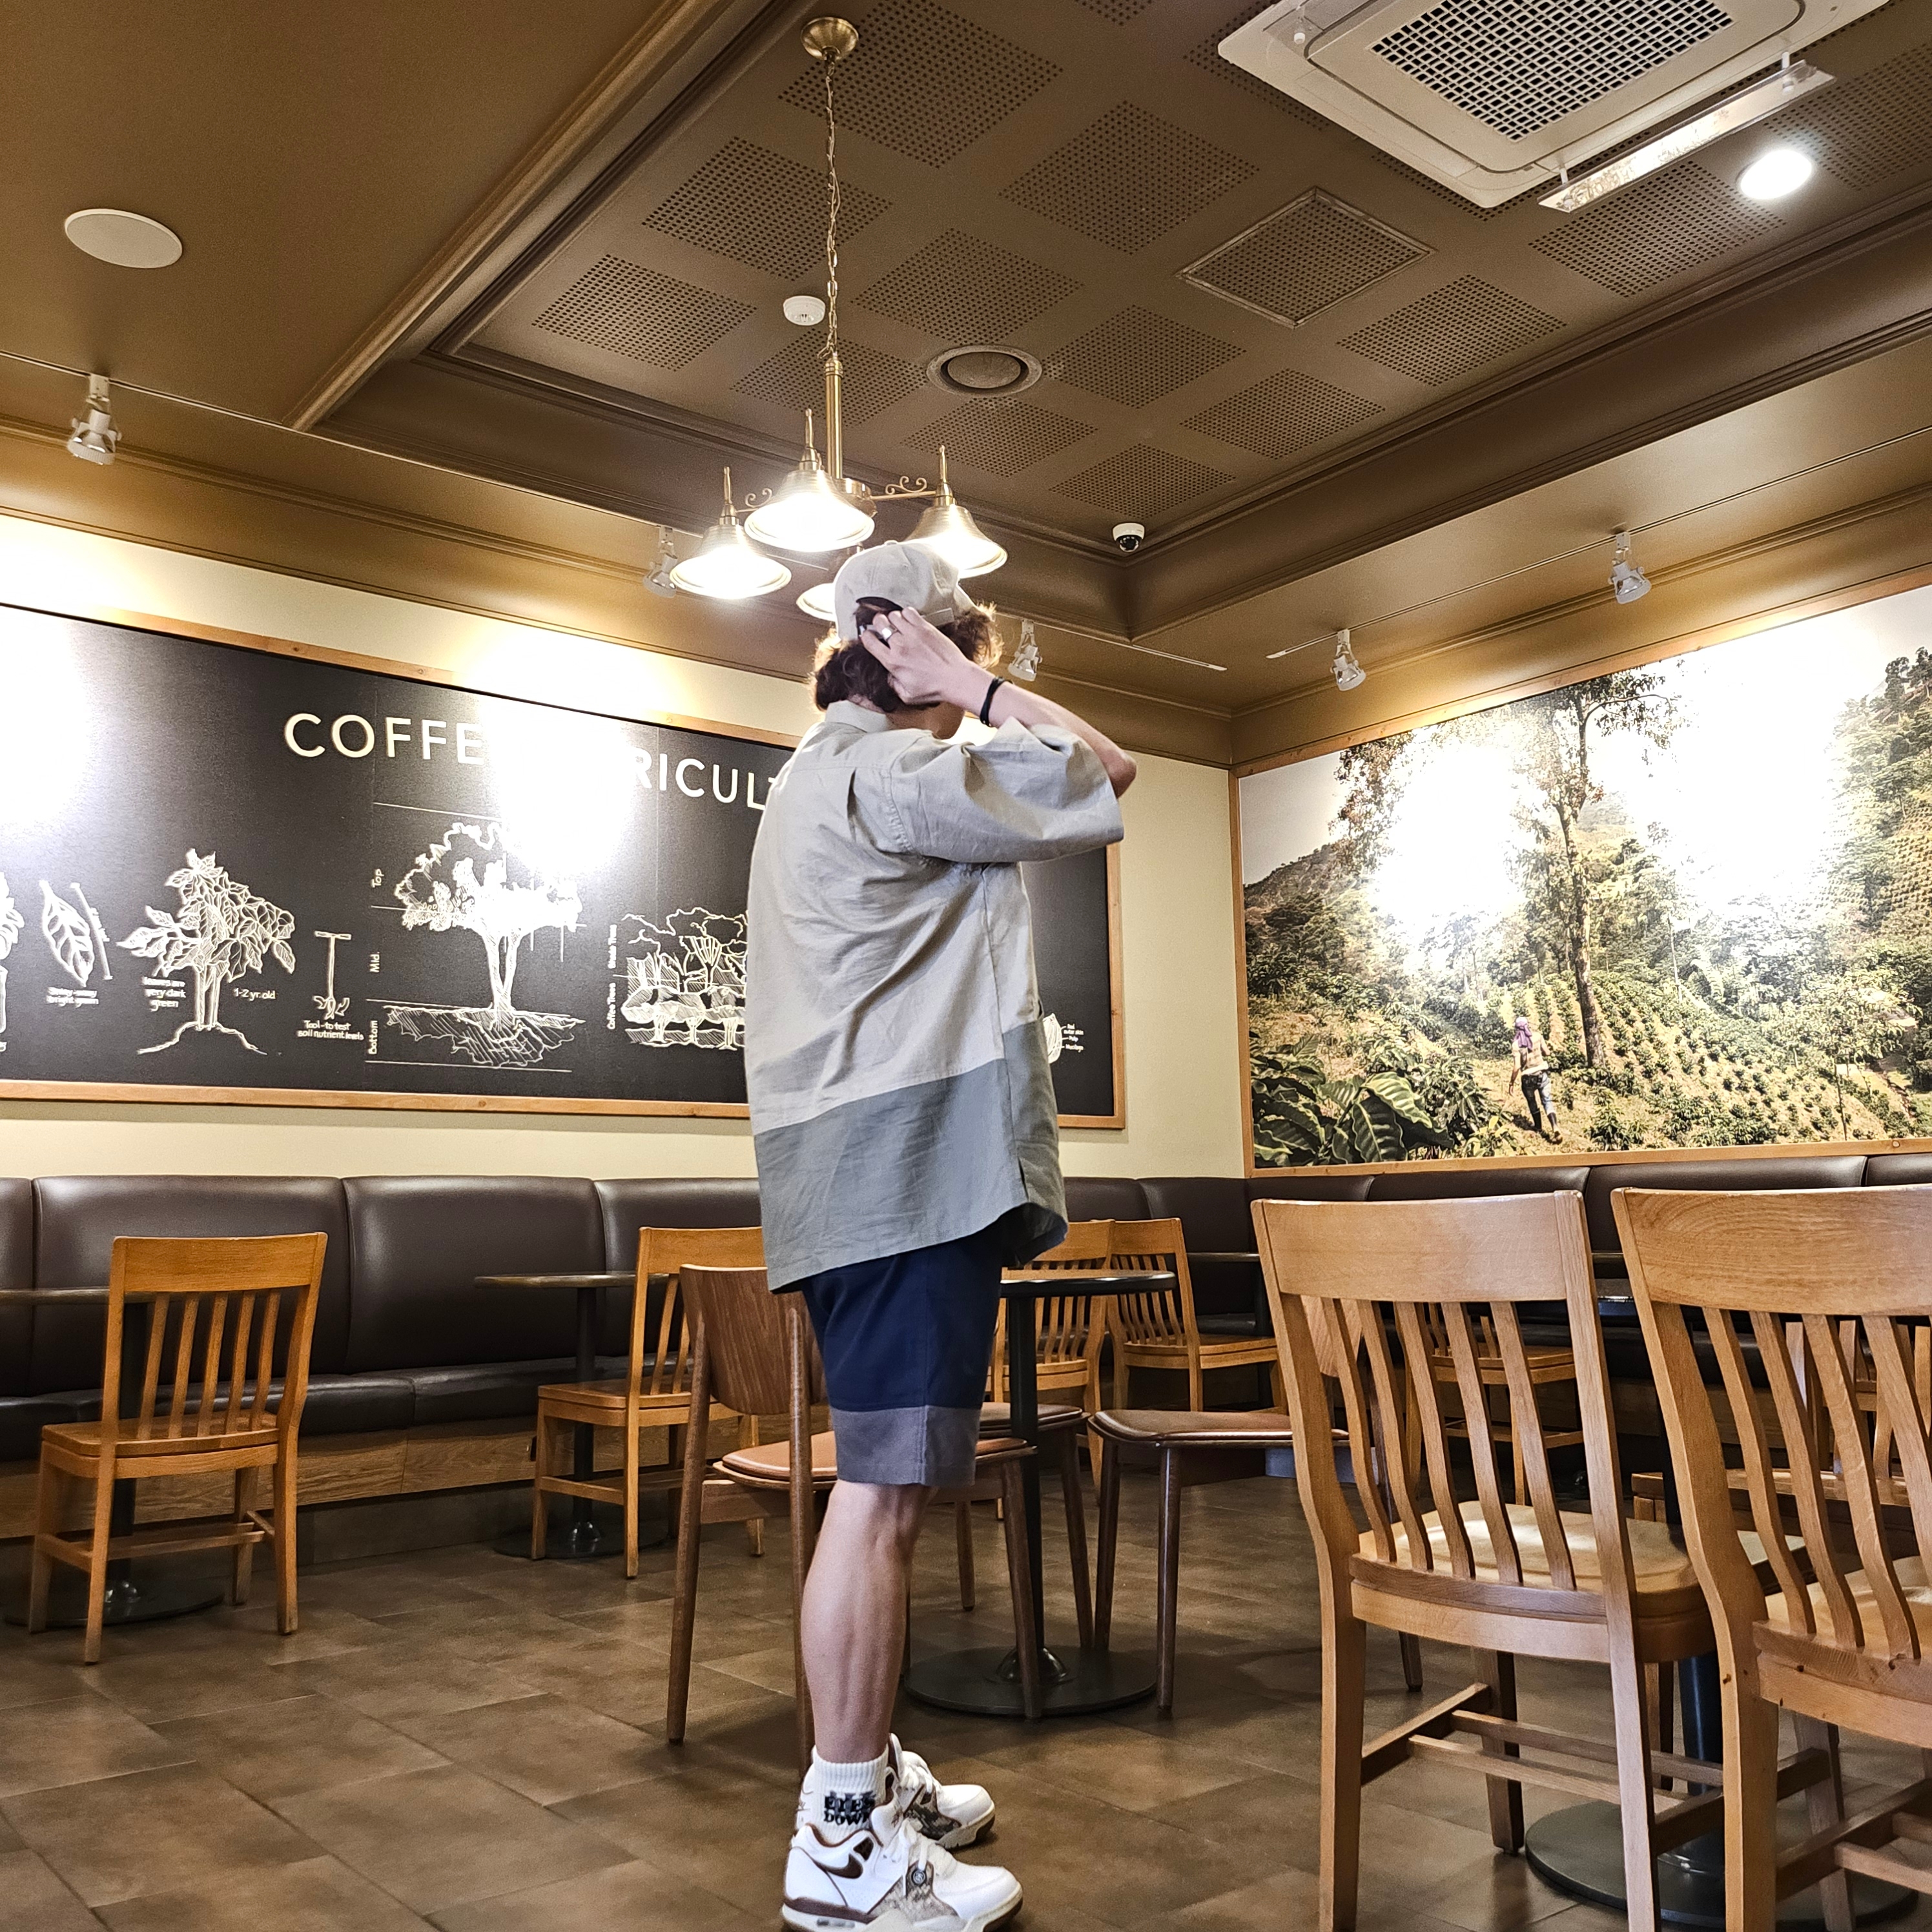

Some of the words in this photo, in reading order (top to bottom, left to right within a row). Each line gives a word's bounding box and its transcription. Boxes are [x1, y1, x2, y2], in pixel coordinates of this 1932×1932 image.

[284, 713, 486, 765] COFFE
[371, 868, 385, 888] Top
[165, 989, 187, 998] dark
[150, 1000, 179, 1012] green
[334, 1022, 351, 1031] test
[313, 1030, 345, 1038] nutrient
[367, 1020, 378, 1054] Bottom
